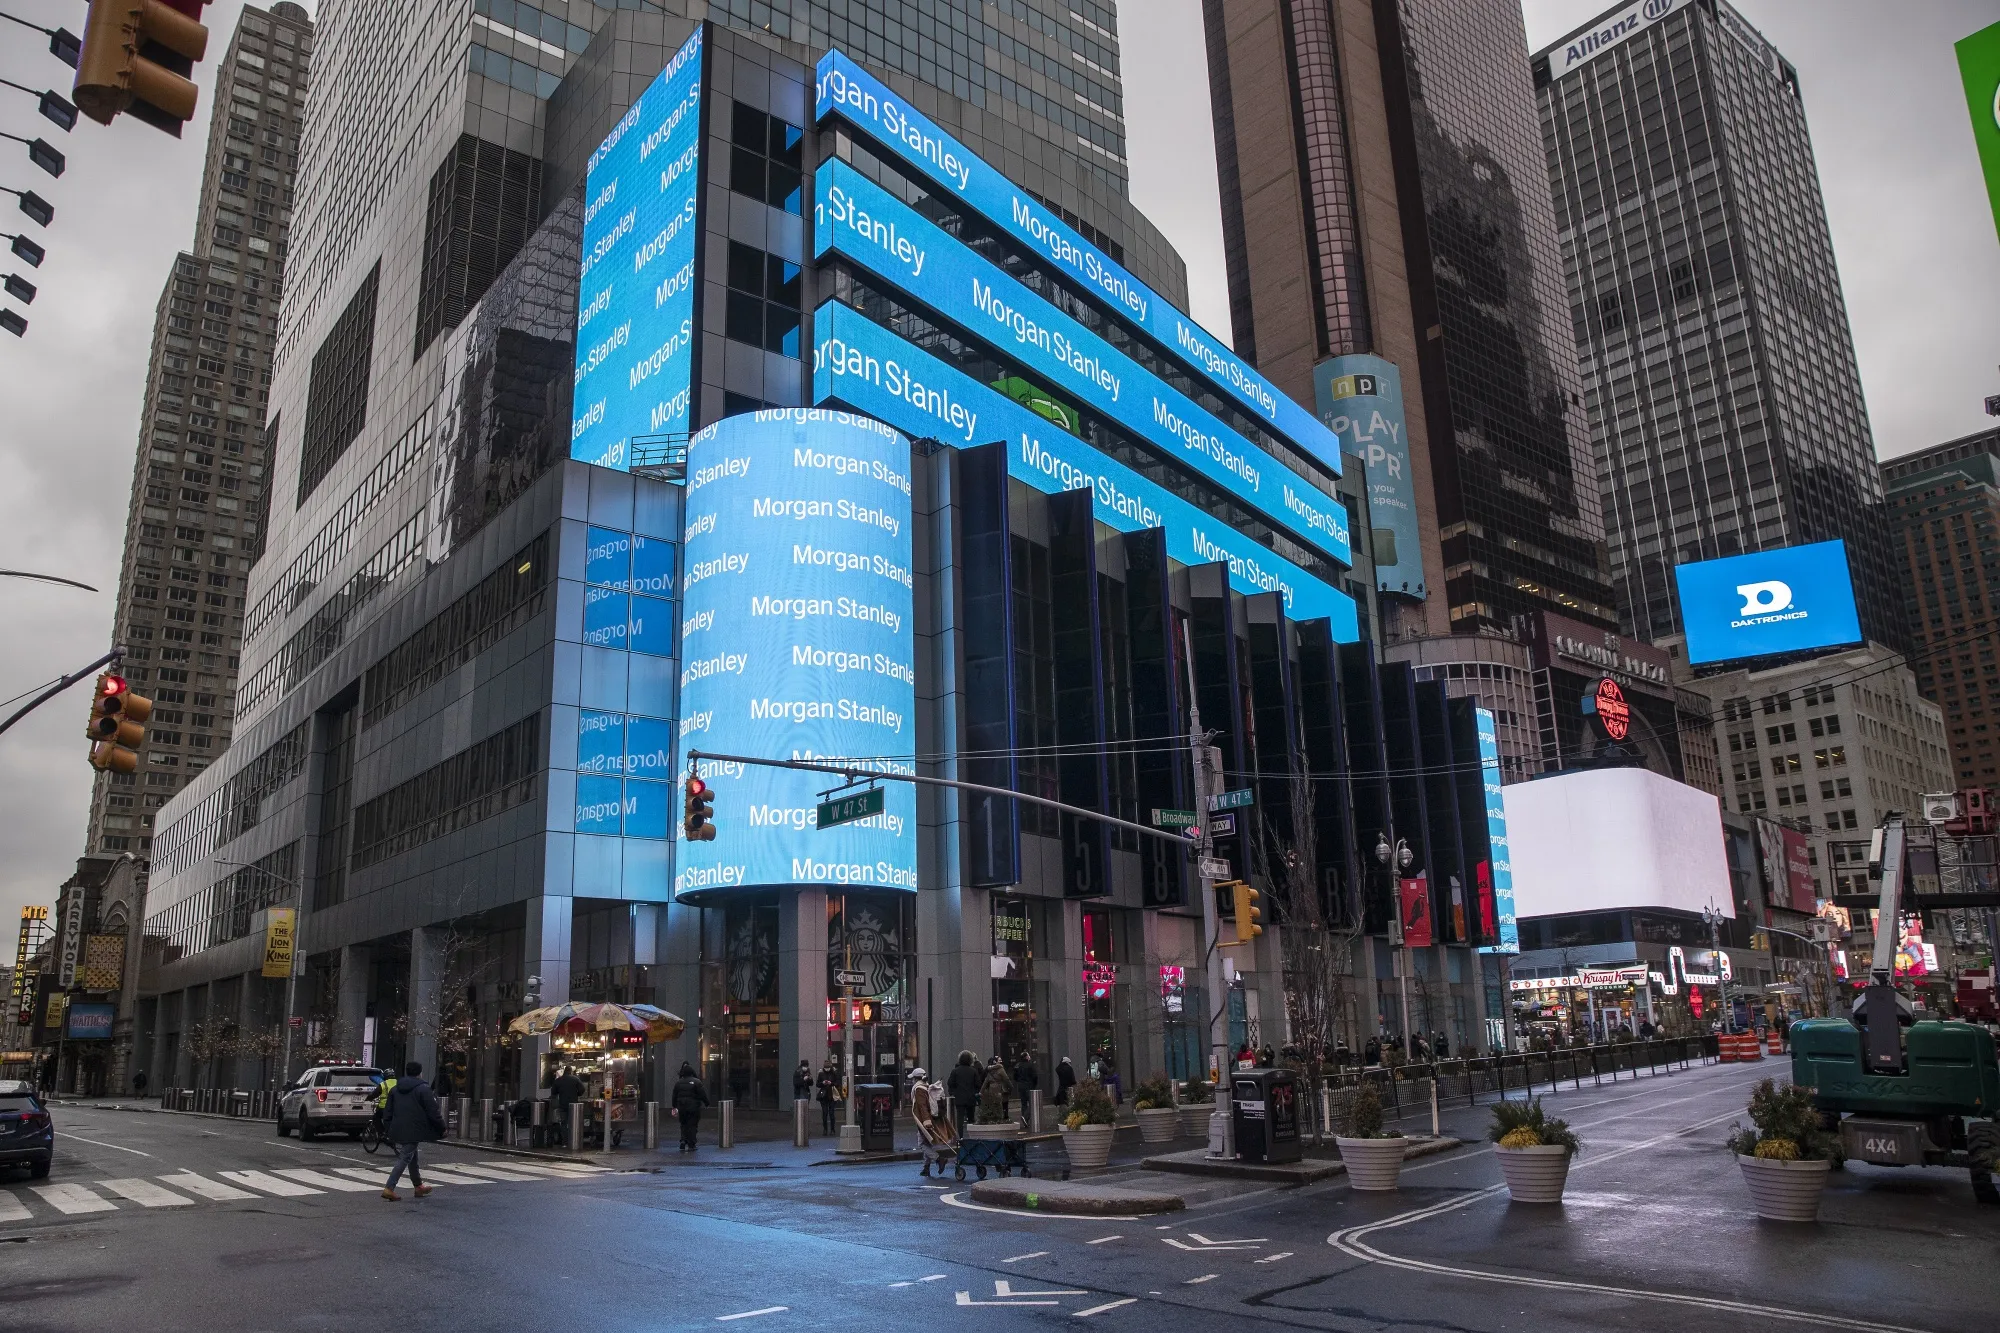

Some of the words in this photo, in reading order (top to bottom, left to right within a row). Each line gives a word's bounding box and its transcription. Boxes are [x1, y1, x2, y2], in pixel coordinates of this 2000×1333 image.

[1565, 14, 1639, 67] Allianz
[1725, 9, 1760, 57] Allianz
[600, 100, 642, 159] Stanley
[640, 100, 687, 163] Morgan
[883, 101, 970, 190] Stanley
[594, 206, 636, 263] Stanley
[635, 213, 682, 274] Morgan
[828, 186, 926, 276] Stanley
[1013, 196, 1082, 272] Morgan
[1086, 252, 1147, 321] Stanley
[588, 319, 631, 372] Stanley
[972, 278, 1050, 354] Morgan
[1054, 332, 1121, 403] Stanley
[630, 334, 677, 391] Morgan
[1177, 321, 1229, 378] Morgan
[1230, 359, 1277, 418] Stanley
[885, 360, 977, 442] Stanley
[1337, 378, 1387, 395] npr
[1153, 397, 1209, 460] Morgan
[1211, 437, 1260, 492] Stanley
[695, 456, 751, 489] Stanley
[794, 448, 869, 476] Morgan
[872, 461, 911, 496] Stanle
[1022, 433, 1095, 492] Morgan
[1098, 477, 1162, 528] Stanley
[1374, 483, 1395, 494] your
[754, 498, 832, 520] Morgan
[837, 499, 899, 537] Stanley
[1283, 485, 1326, 530] Morgan
[1374, 496, 1408, 510] speaker.
[693, 552, 749, 583] Stanley
[794, 545, 870, 572] Morgan
[873, 554, 913, 589] Stanle
[1247, 560, 1294, 608] Stanley
[752, 596, 832, 619] Morgan
[837, 597, 900, 633] Stanley
[1731, 611, 1808, 628] DAKTRONICS
[691, 652, 748, 681] Stanley
[793, 645, 871, 672] Morgan
[874, 654, 914, 687] Stanle
[751, 698, 833, 723] Morgan
[838, 699, 902, 733] Stanley
[750, 804, 817, 830] Morga
[832, 806, 839, 819] W
[844, 802, 853, 816] 47
[858, 798, 867, 813] St
[1162, 812, 1195, 825] Broadway
[1219, 795, 1227, 807] W
[1231, 793, 1241, 805] 47
[1211, 821, 1227, 832] WAY
[686, 862, 746, 887] Stanley
[792, 858, 873, 884] Morgan
[876, 862, 917, 888] Stanle
[1203, 864, 1213, 872] ONE
[22, 906, 48, 920] MTC
[62, 890, 82, 984] BARRYMORE
[266, 950, 290, 962] KING
[271, 937, 289, 948] LION
[13, 928, 27, 996] FRIEDMAN
[853, 974, 863, 982] WAY
[1583, 971, 1614, 984] Krispy
[21, 978, 34, 1012] PARK
[1866, 1138, 1897, 1154] 4X4
